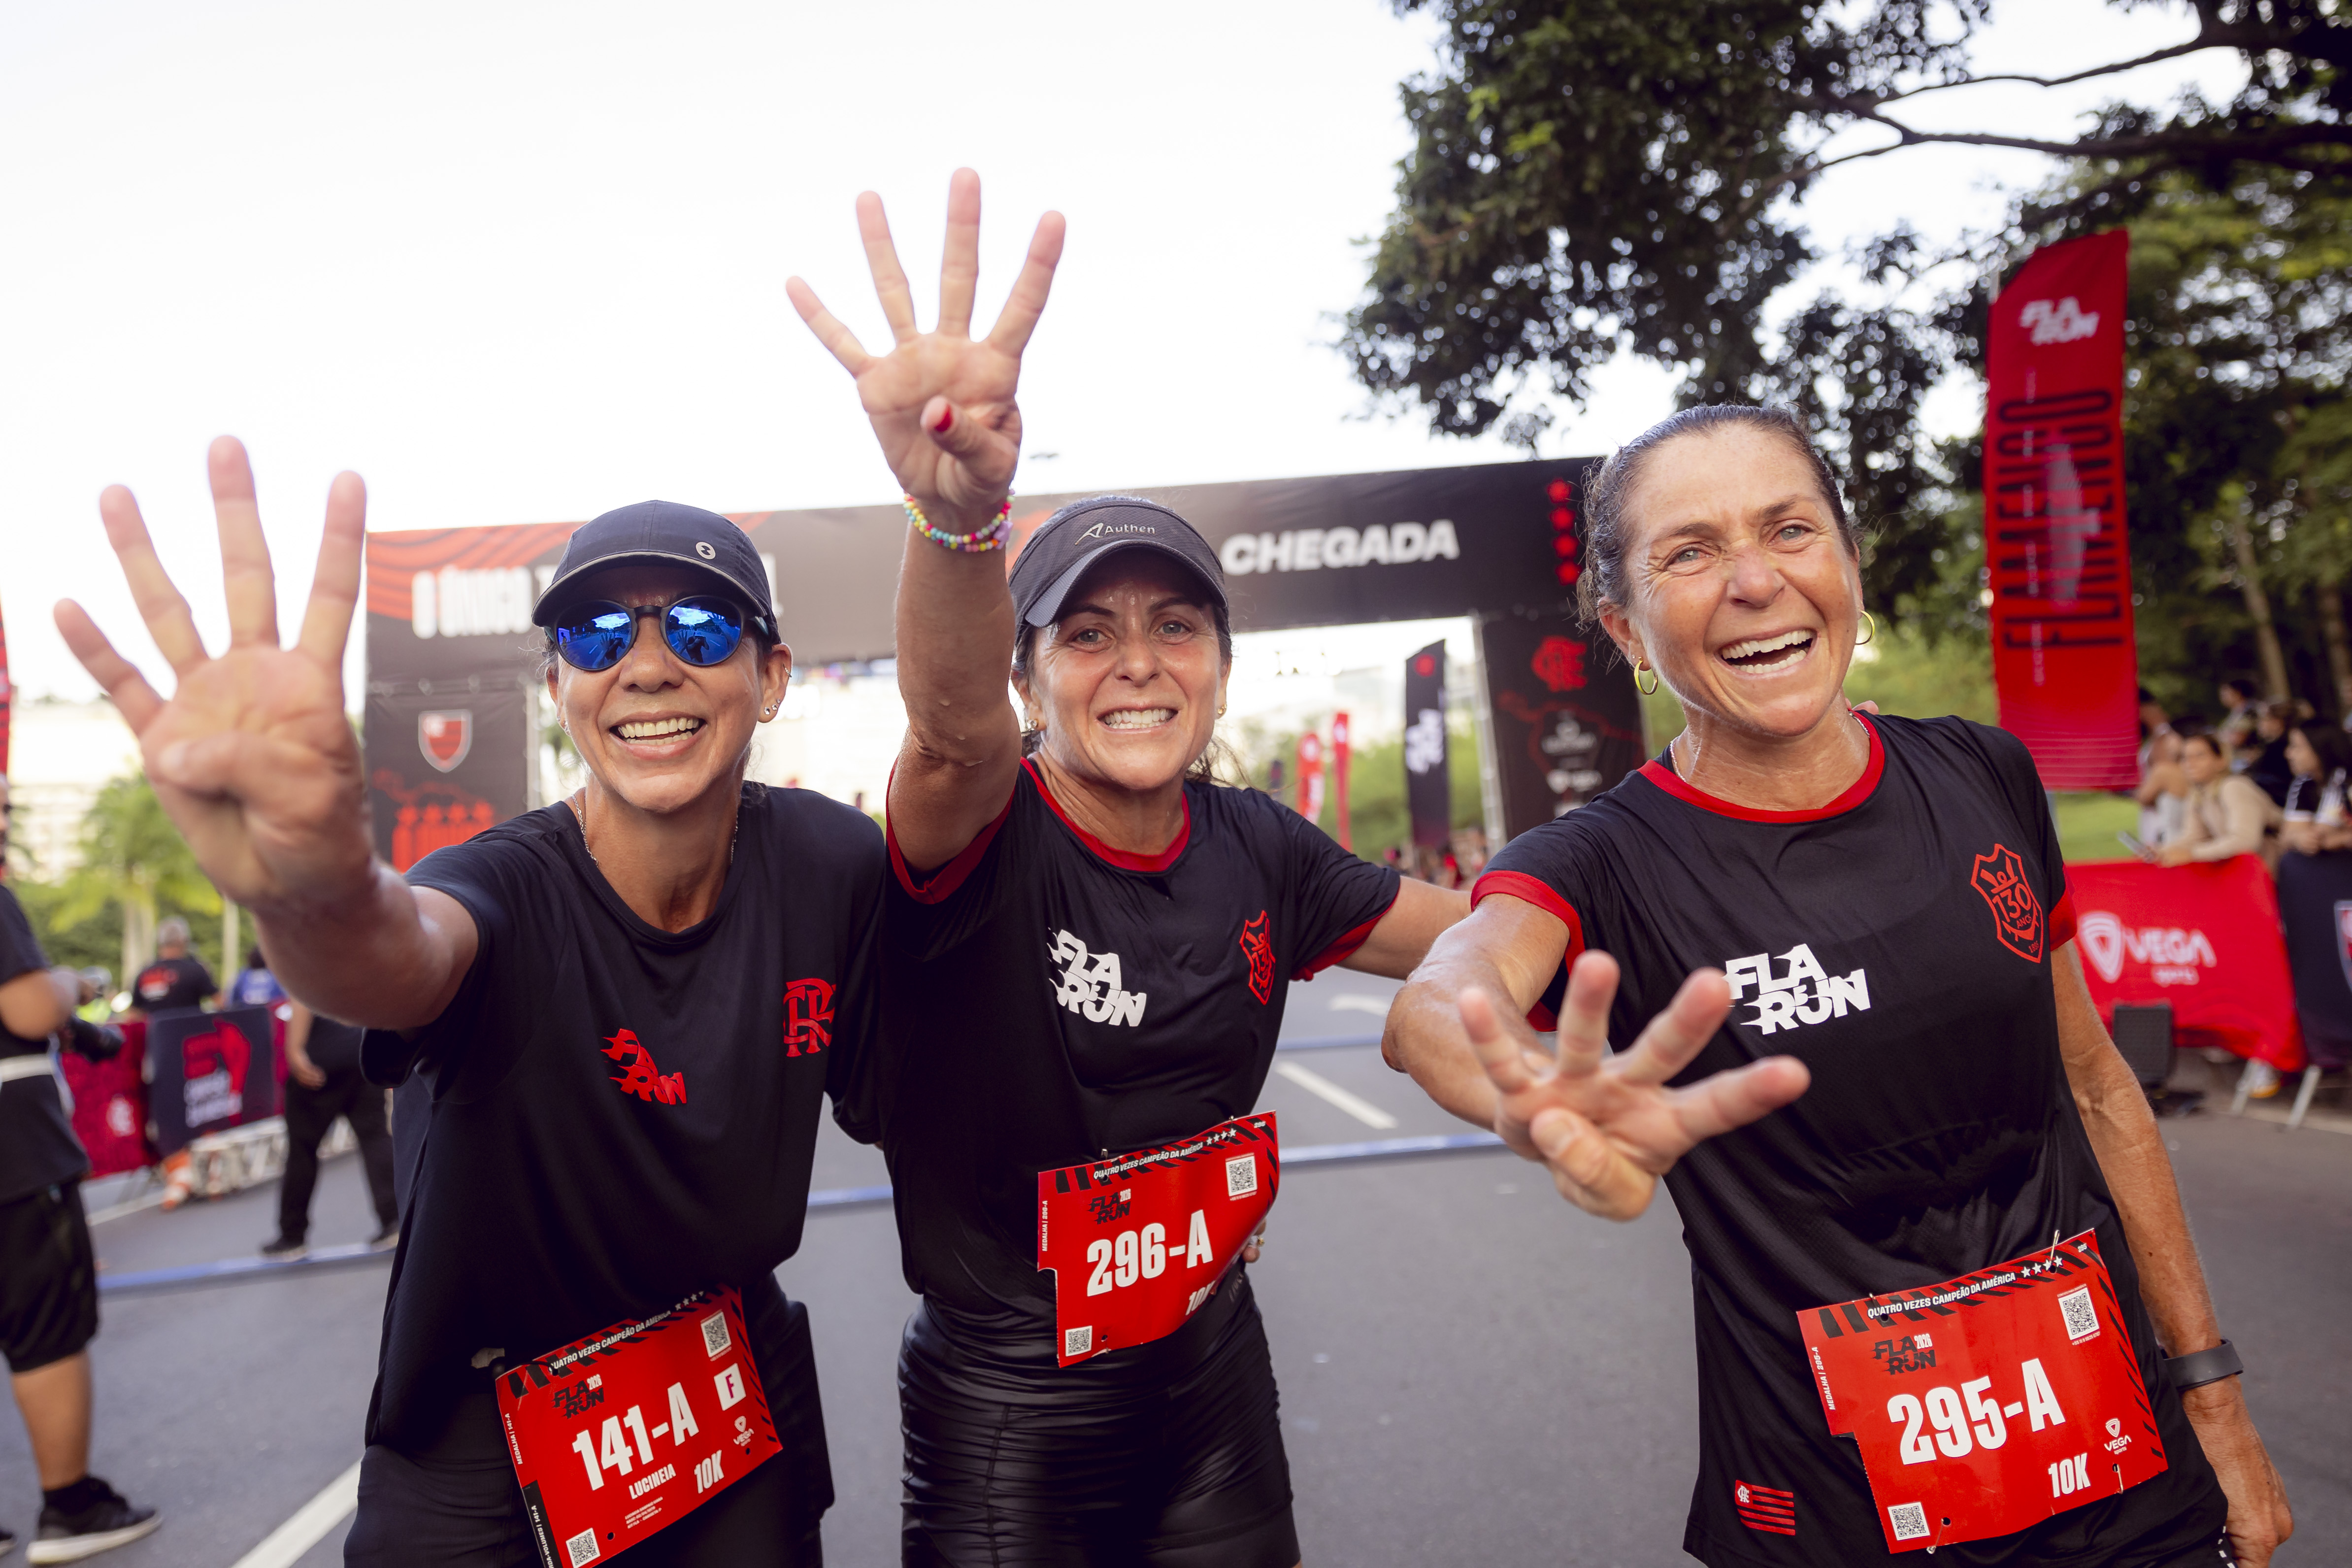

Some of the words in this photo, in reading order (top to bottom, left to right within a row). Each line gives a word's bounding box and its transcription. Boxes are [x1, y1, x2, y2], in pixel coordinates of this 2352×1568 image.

[1104, 524, 1156, 535] Authen
[1220, 519, 1460, 576] CHEGADA
[1992, 883, 2032, 923] 130
[2122, 927, 2217, 968] VEGA
[1723, 943, 1828, 999] FLA
[1049, 969, 1147, 1027] RUN
[1739, 968, 1871, 1035] RUN
[1093, 1166, 1120, 1180] QUATRO
[1120, 1160, 1139, 1171] VEZES
[1139, 1151, 1169, 1166] CAMPEÃO
[1180, 1142, 1203, 1157] AMÉRICA
[1087, 1192, 1121, 1212] FLA
[1093, 1201, 1131, 1225] RUN
[1087, 1209, 1214, 1297] 296-A
[1867, 1303, 1902, 1319] QUATRO
[1903, 1298, 1931, 1310] VEZES
[1932, 1286, 1970, 1305] CAMPEÃO
[1971, 1283, 1981, 1295] DA
[1982, 1272, 2016, 1291] AMÉRICA
[578, 1342, 601, 1358] VEZES
[601, 1326, 635, 1348] CAMPEÃO
[635, 1322, 645, 1332] DA
[1871, 1335, 1918, 1360] FLA
[1914, 1333, 1933, 1349] 2026
[1882, 1349, 1936, 1375] RUN
[551, 1380, 590, 1408] FLA
[561, 1387, 605, 1419] RUN
[726, 1373, 734, 1399] F
[1821, 1376, 1836, 1410] MEDALHA
[504, 1413, 513, 1430] 141-A
[1887, 1358, 2065, 1465] 295-A
[510, 1434, 523, 1465] MEDALHA
[572, 1381, 699, 1491] 141-A
[2104, 1434, 2132, 1451] VEGA
[629, 1463, 677, 1500] LUCINEIA
[694, 1449, 725, 1494] 10K
[2048, 1453, 2091, 1498] 10K
[531, 1505, 541, 1523] 141-A
